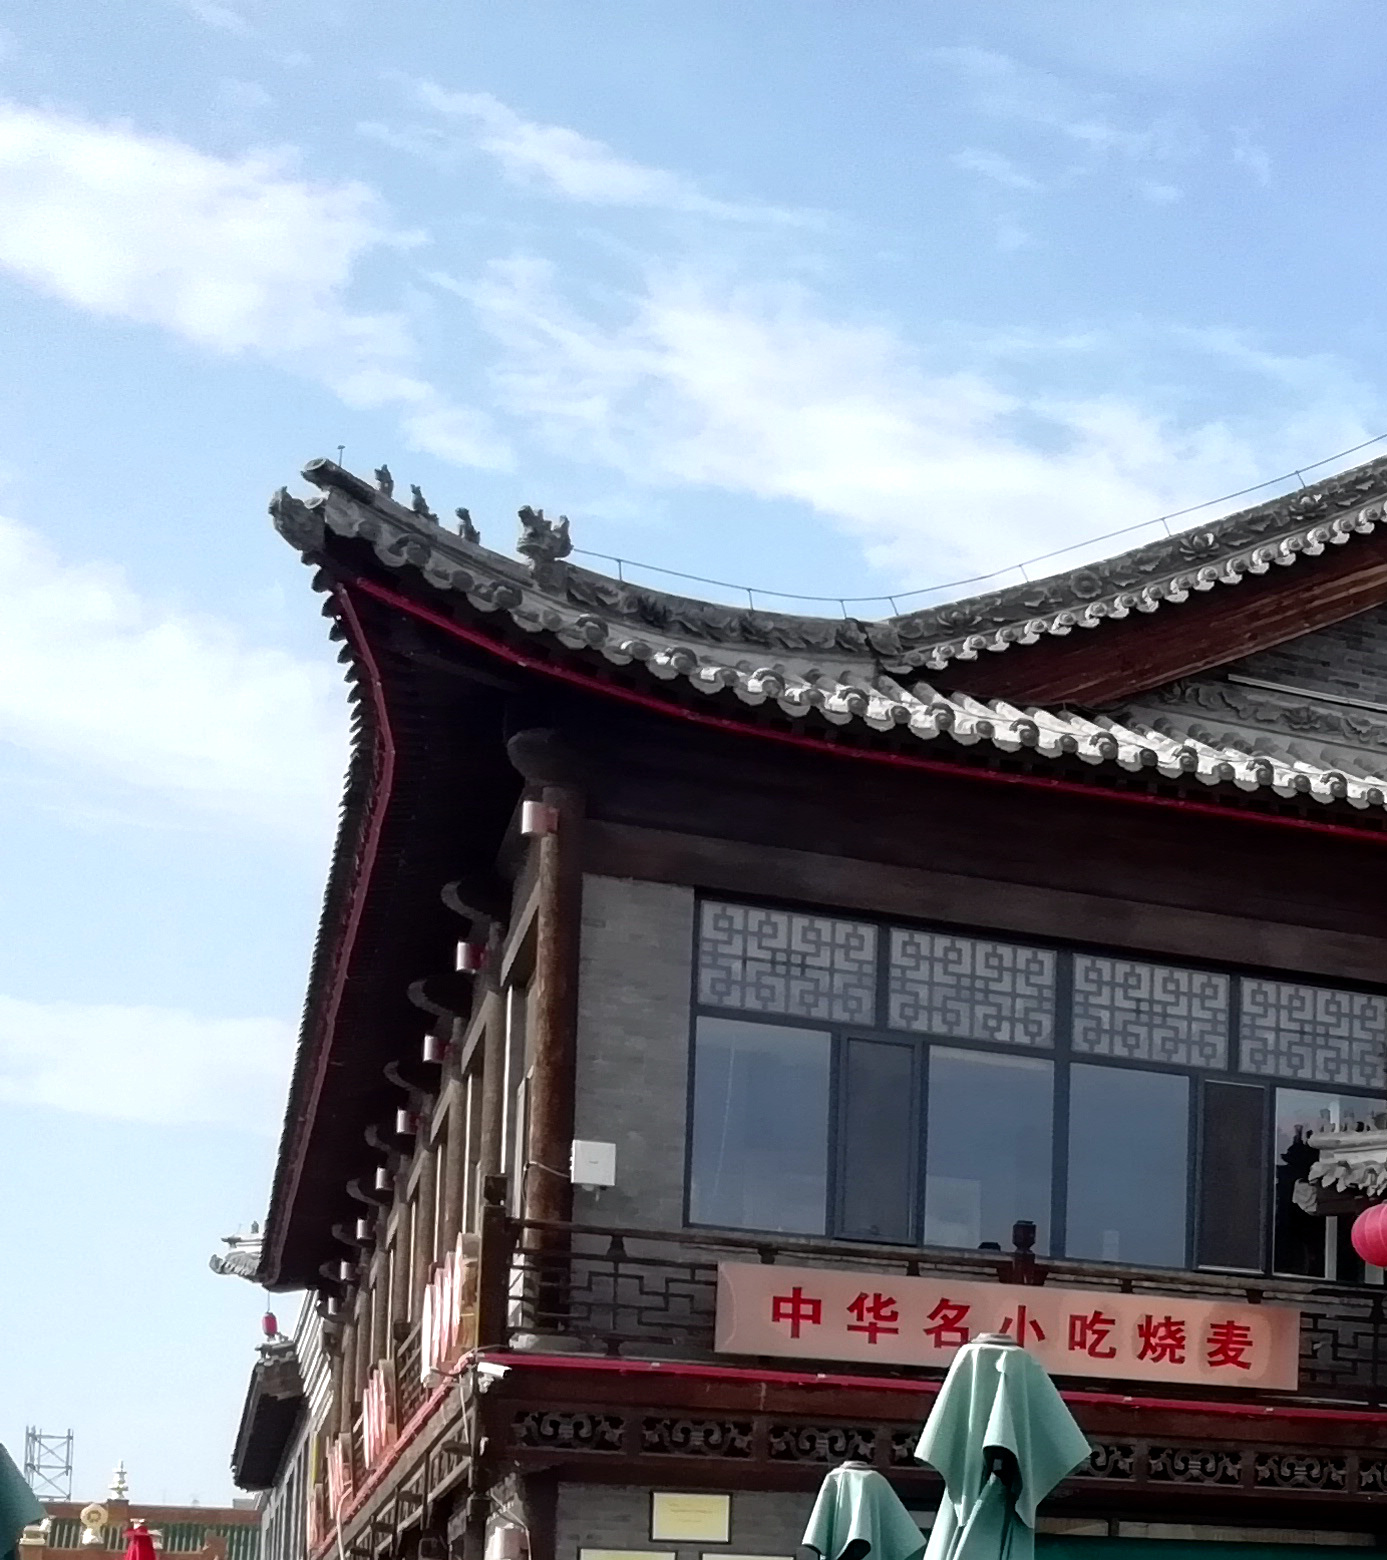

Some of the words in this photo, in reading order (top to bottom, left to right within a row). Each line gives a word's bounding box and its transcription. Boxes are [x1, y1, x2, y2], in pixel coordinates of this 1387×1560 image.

[771, 1286, 1255, 1371] 中华名小吃烧麦
